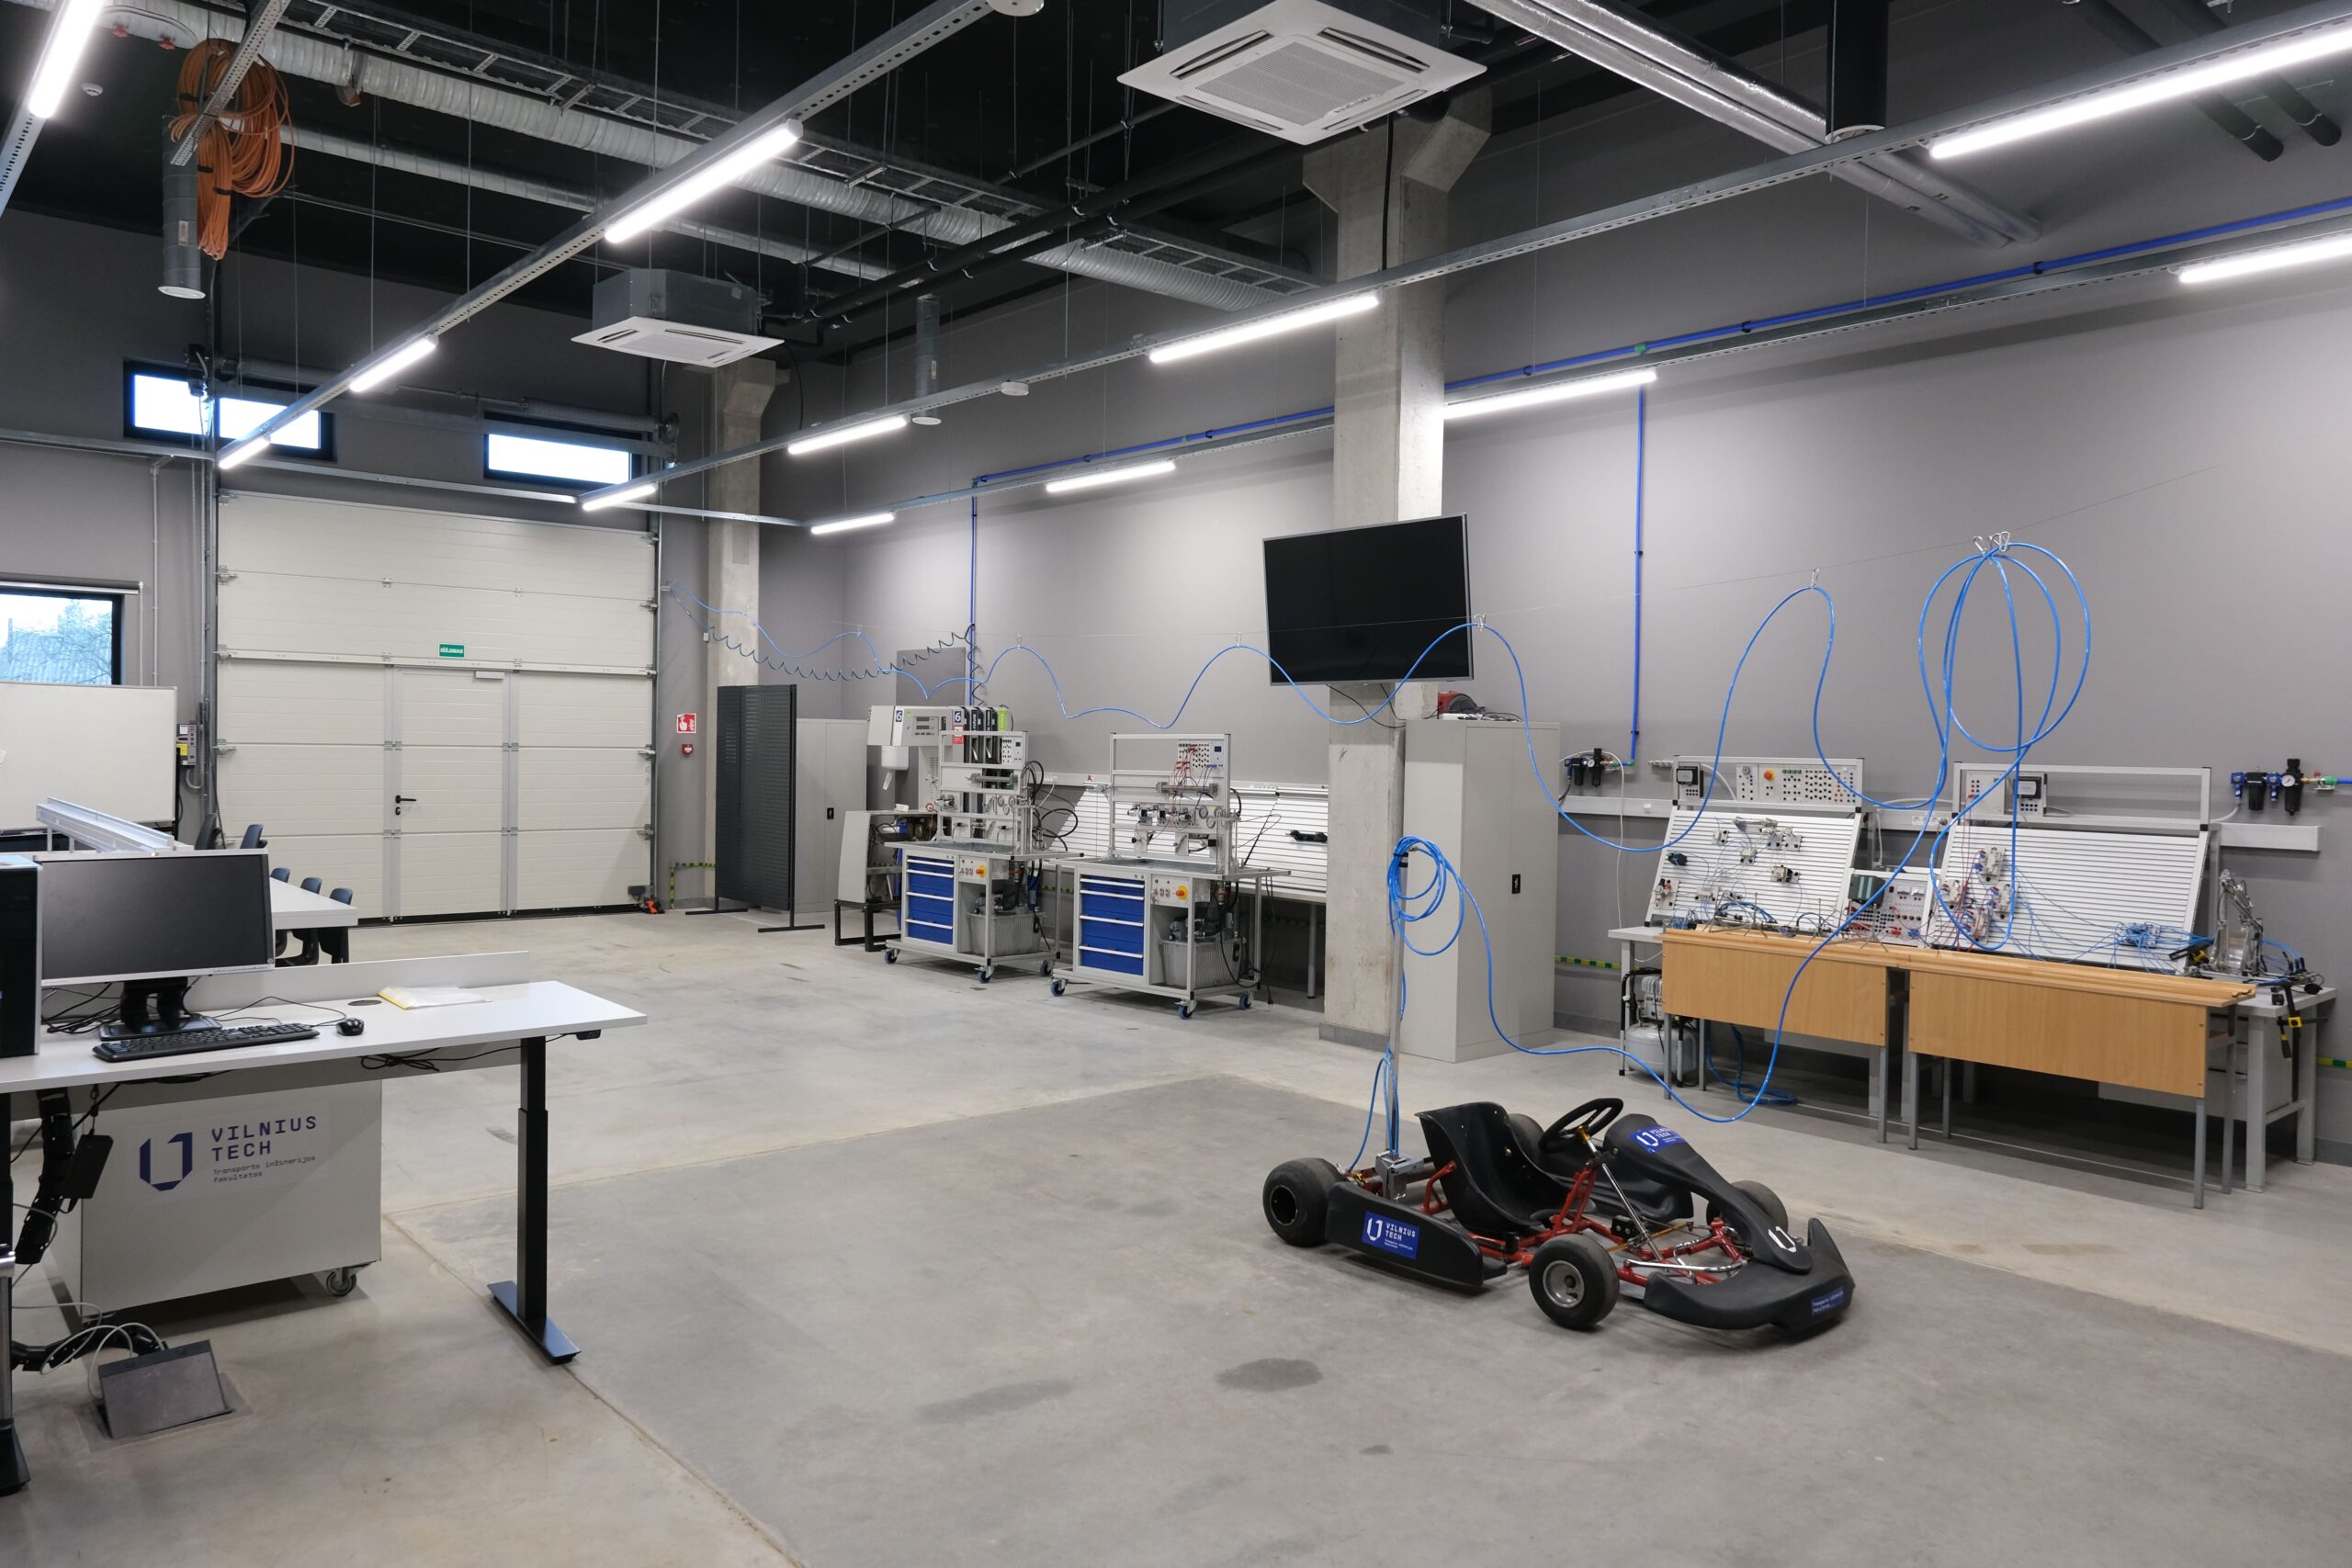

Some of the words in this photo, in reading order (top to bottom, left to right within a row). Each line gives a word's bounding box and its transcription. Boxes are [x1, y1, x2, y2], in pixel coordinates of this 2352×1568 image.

[896, 711, 902, 721] 6
[956, 711, 961, 722] 6
[211, 1116, 317, 1143] VILNIUS
[211, 1140, 271, 1161] TECH
[213, 1164, 260, 1175] Transporto
[266, 1156, 316, 1168] inžinerijos
[213, 1171, 263, 1183] fakultetas
[1385, 1222, 1416, 1237] VILNIUS
[1385, 1230, 1402, 1241] TECH
